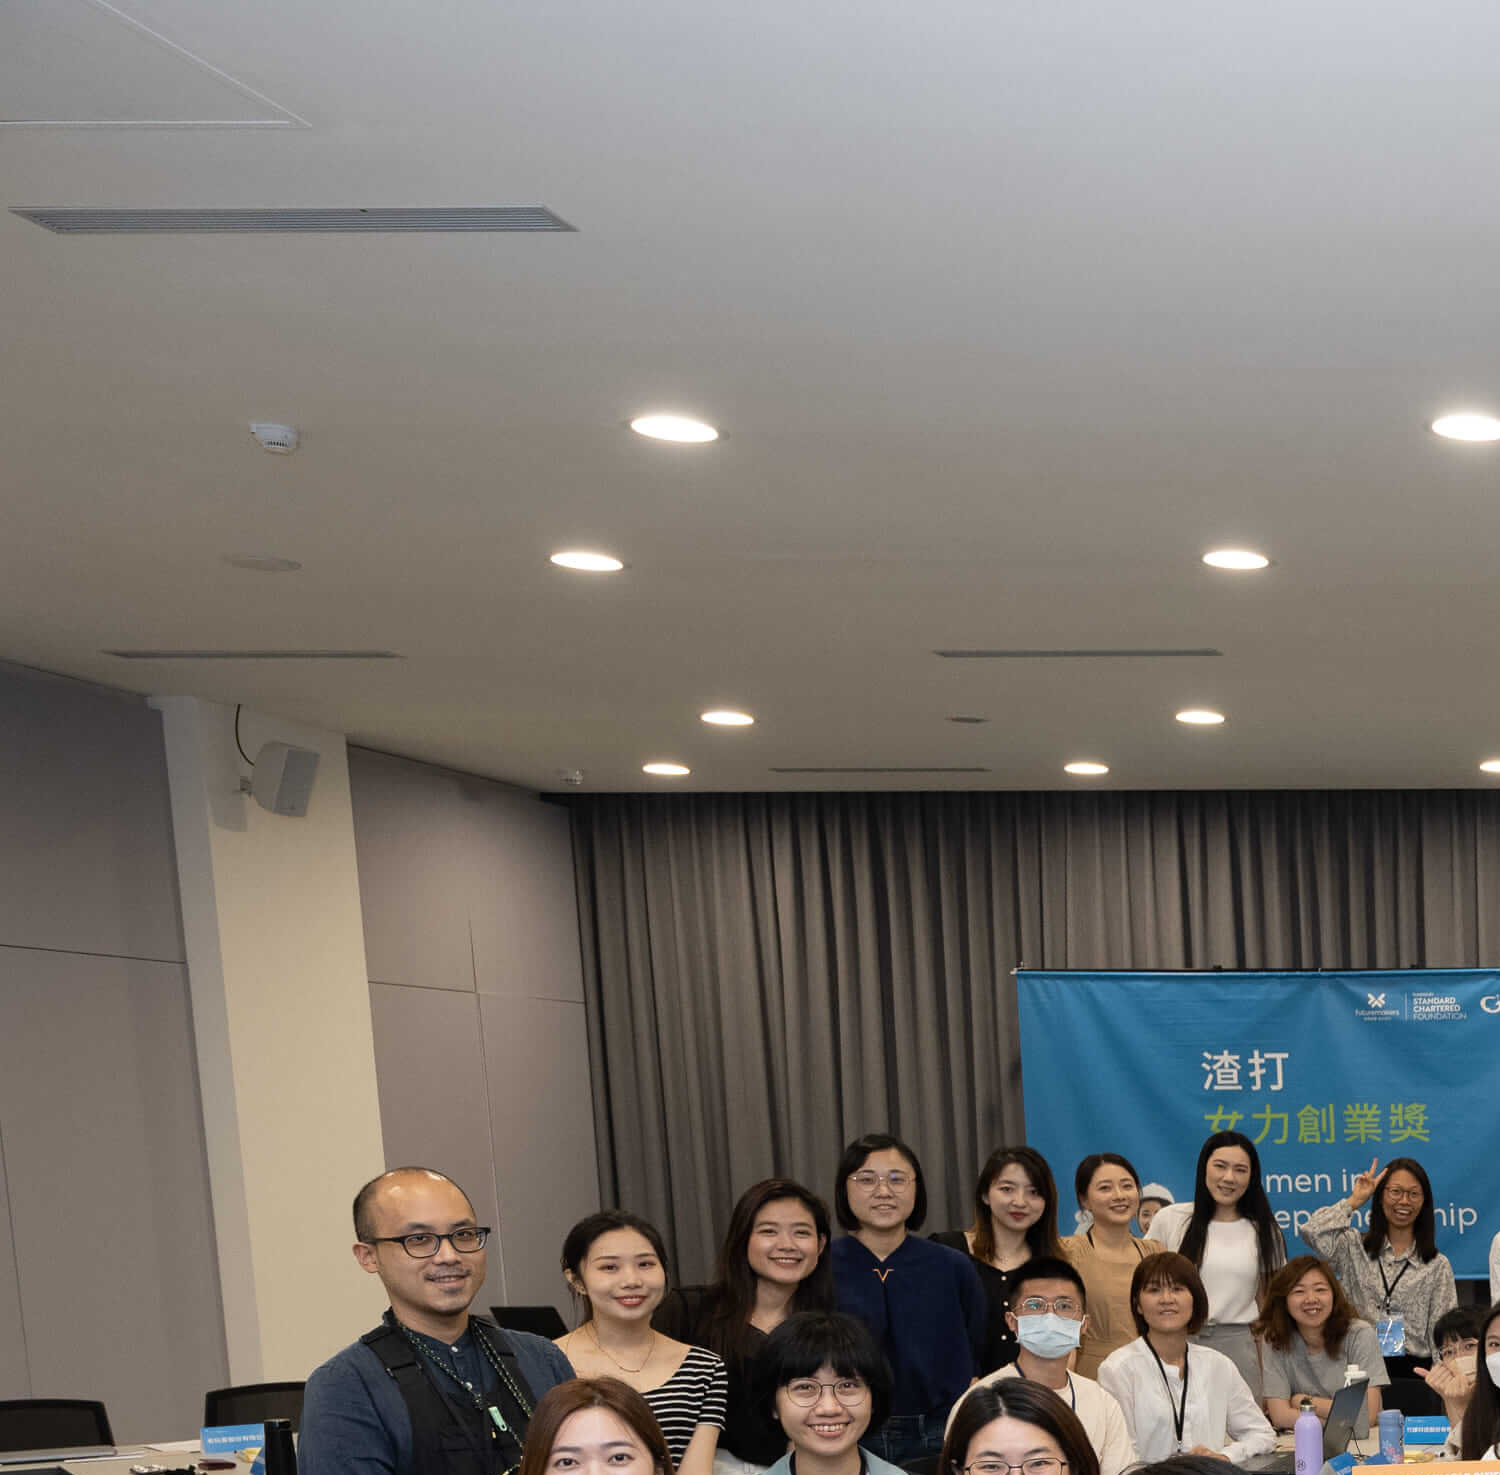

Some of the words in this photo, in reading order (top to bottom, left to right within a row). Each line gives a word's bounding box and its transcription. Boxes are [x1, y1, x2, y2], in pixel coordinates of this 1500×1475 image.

[1413, 997, 1456, 1005] STANDARD
[1413, 1004, 1460, 1012] CHARTERED
[1201, 1049, 1289, 1091] 渣打
[1204, 1103, 1430, 1144] 女力創業獎
[1265, 1173, 1331, 1193] men
